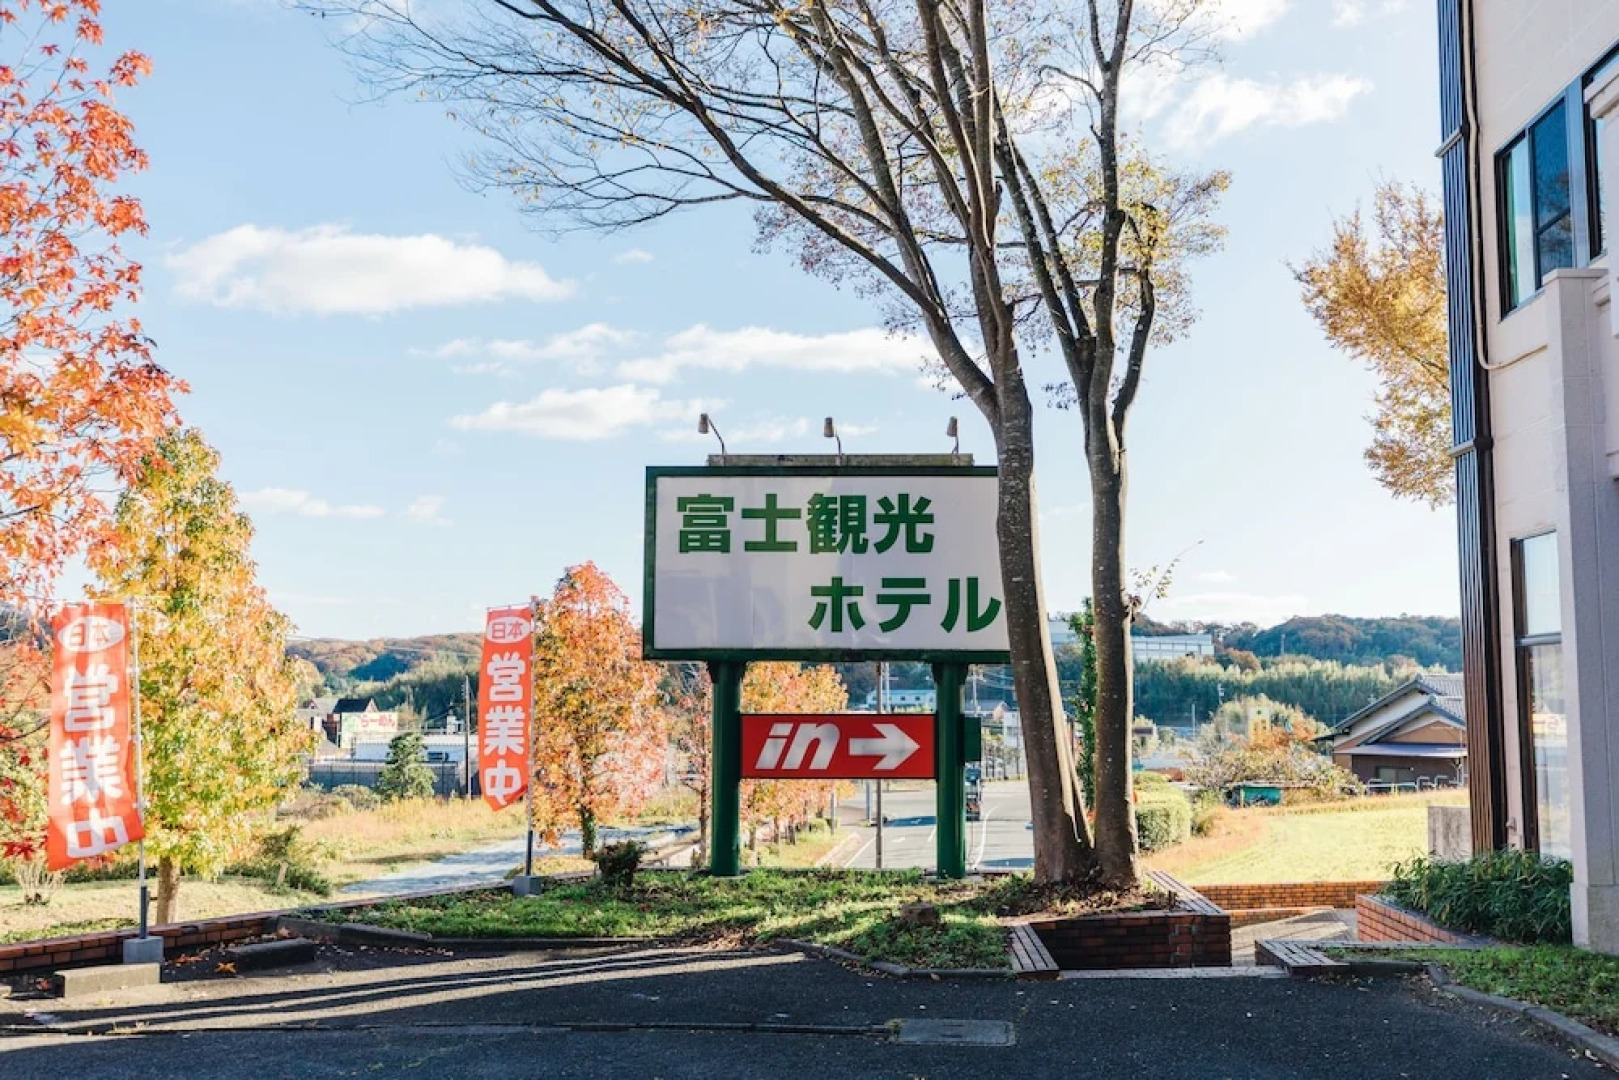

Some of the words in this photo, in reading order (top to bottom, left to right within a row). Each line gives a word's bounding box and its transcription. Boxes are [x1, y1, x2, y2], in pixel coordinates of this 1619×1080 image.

[677, 493, 935, 554] 富士観光
[491, 621, 523, 639] 日本
[809, 576, 1002, 633] ホテル
[69, 623, 109, 647] 日本
[484, 651, 526, 806] 営業中
[755, 722, 841, 770] in
[60, 663, 129, 858] 営業中
